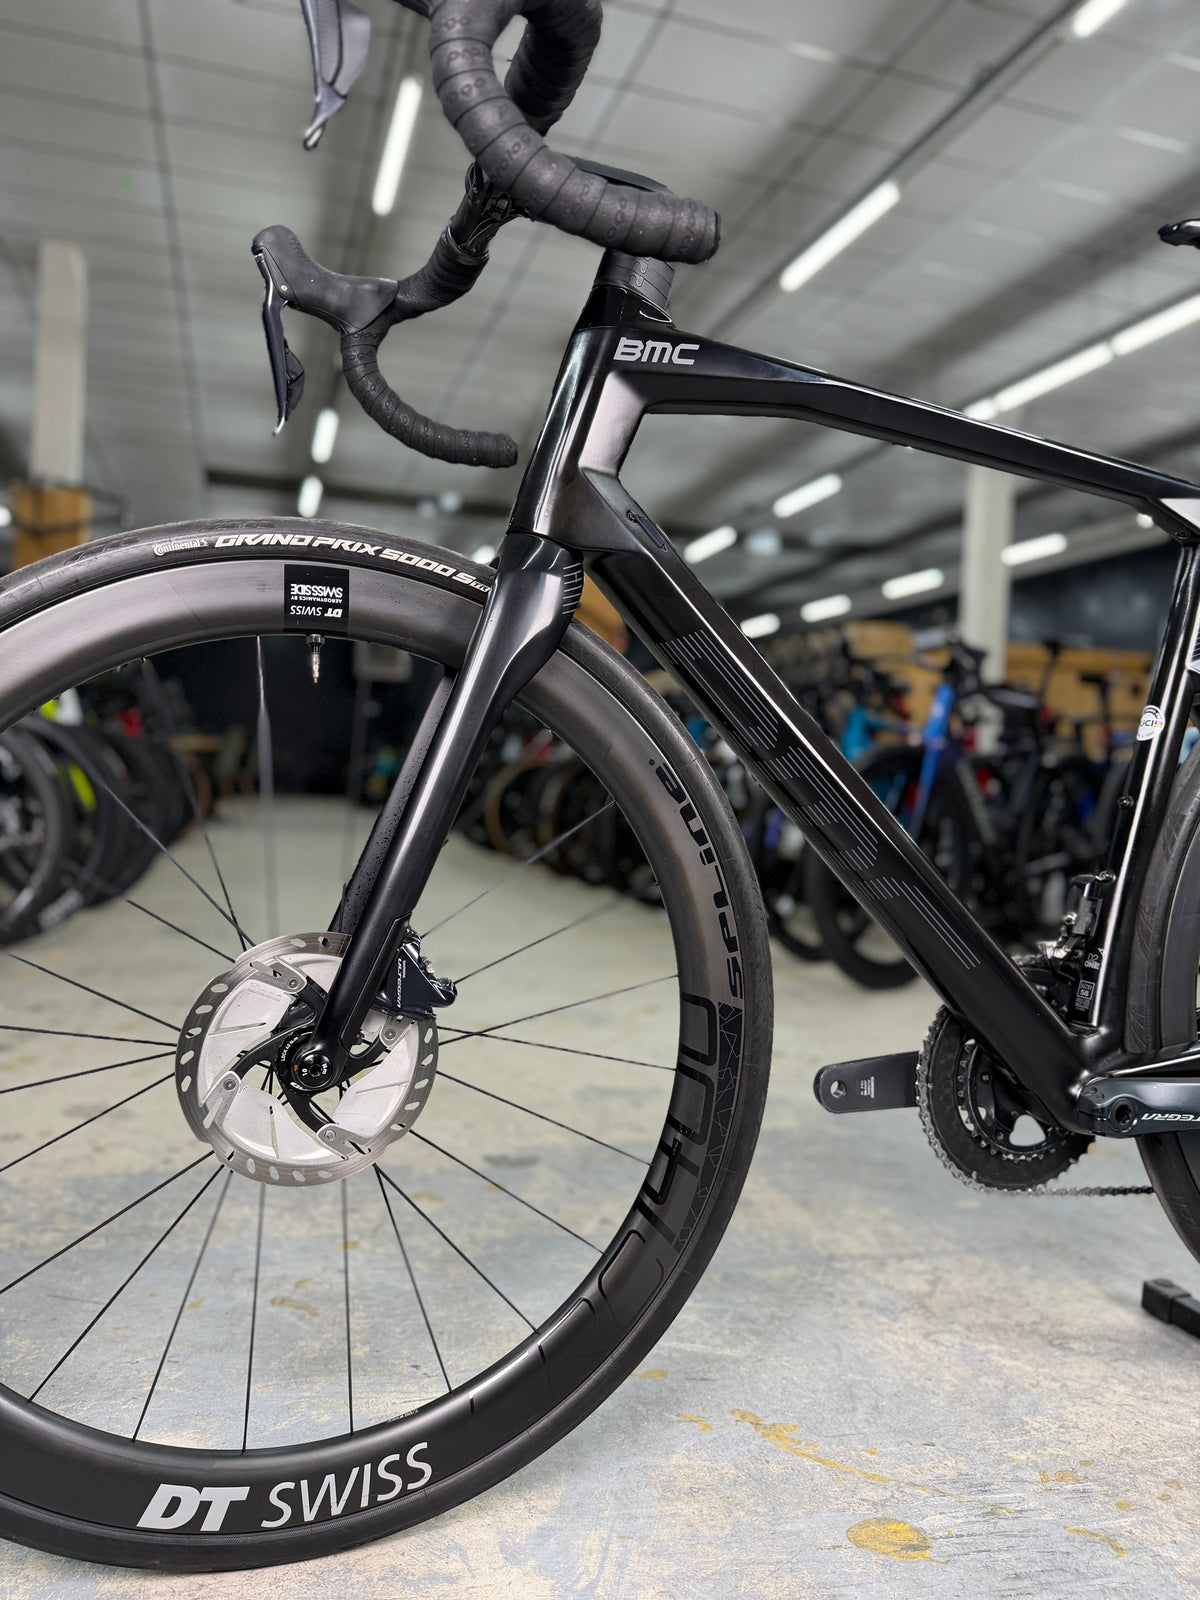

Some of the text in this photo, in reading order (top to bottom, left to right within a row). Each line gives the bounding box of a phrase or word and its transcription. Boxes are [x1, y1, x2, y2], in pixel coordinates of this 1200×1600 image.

[613, 337, 700, 365] BMC
[153, 538, 201, 556] Continental
[214, 533, 313, 548] GRAND
[312, 536, 383, 557] PRIX
[379, 548, 457, 577] 5000
[290, 604, 343, 618] DT SWISS
[299, 595, 343, 604] AERODYNAMICS
[136, 1442, 433, 1532] DT SWISS
